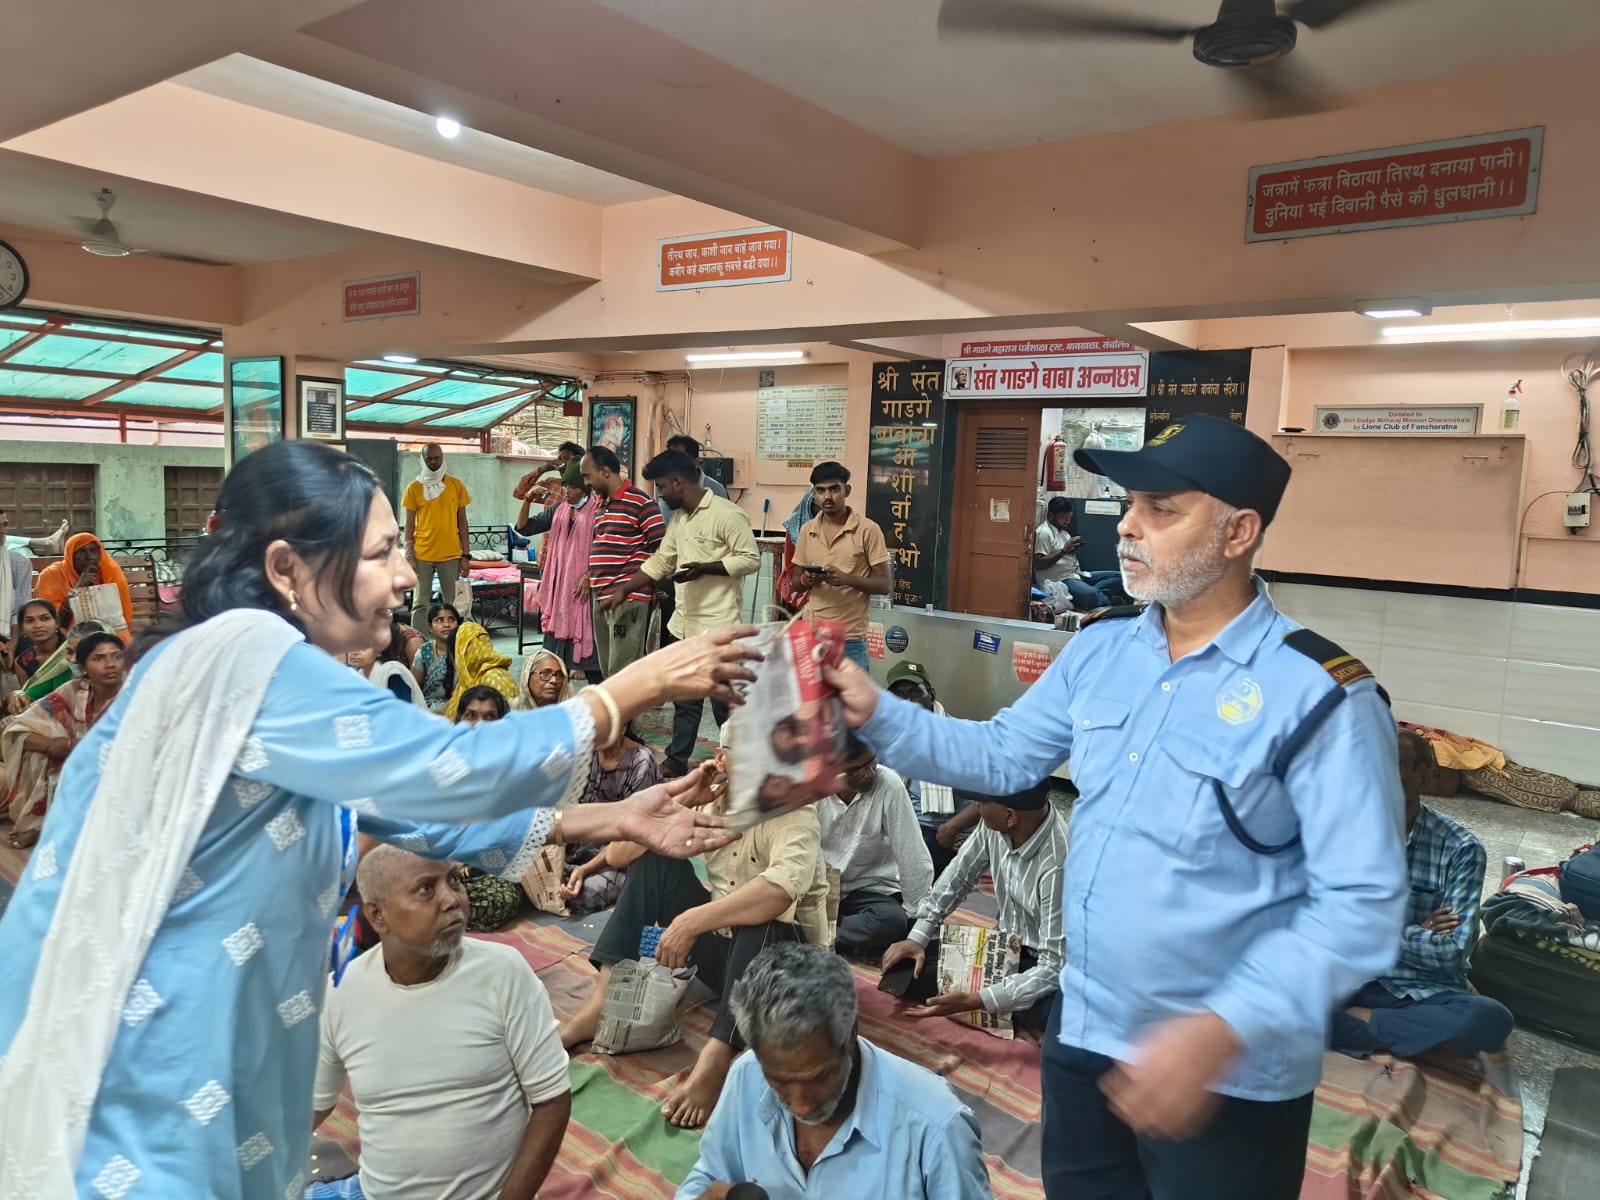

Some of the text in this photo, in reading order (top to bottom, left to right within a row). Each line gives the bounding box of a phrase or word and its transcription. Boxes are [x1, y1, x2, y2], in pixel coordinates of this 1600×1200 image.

[1337, 169, 1383, 189] बिठाया
[1386, 162, 1426, 183] तिरथ
[1430, 157, 1476, 177] बनाया
[1265, 202, 1304, 228] दुनिया
[1307, 196, 1328, 218] भई
[1332, 190, 1376, 215] दिवानी
[1380, 187, 1404, 208] पैसे
[1408, 183, 1429, 205] की
[701, 241, 718, 257] काशी
[669, 262, 685, 277] कबीर
[686, 261, 697, 276] कहे
[725, 256, 741, 272] सबसे
[877, 364, 942, 392] श्री संत
[974, 361, 1142, 390] संत गाडगे बाबा अन्नछत्र
[881, 392, 932, 419] गाडगे
[874, 420, 938, 445] बाबांचा
